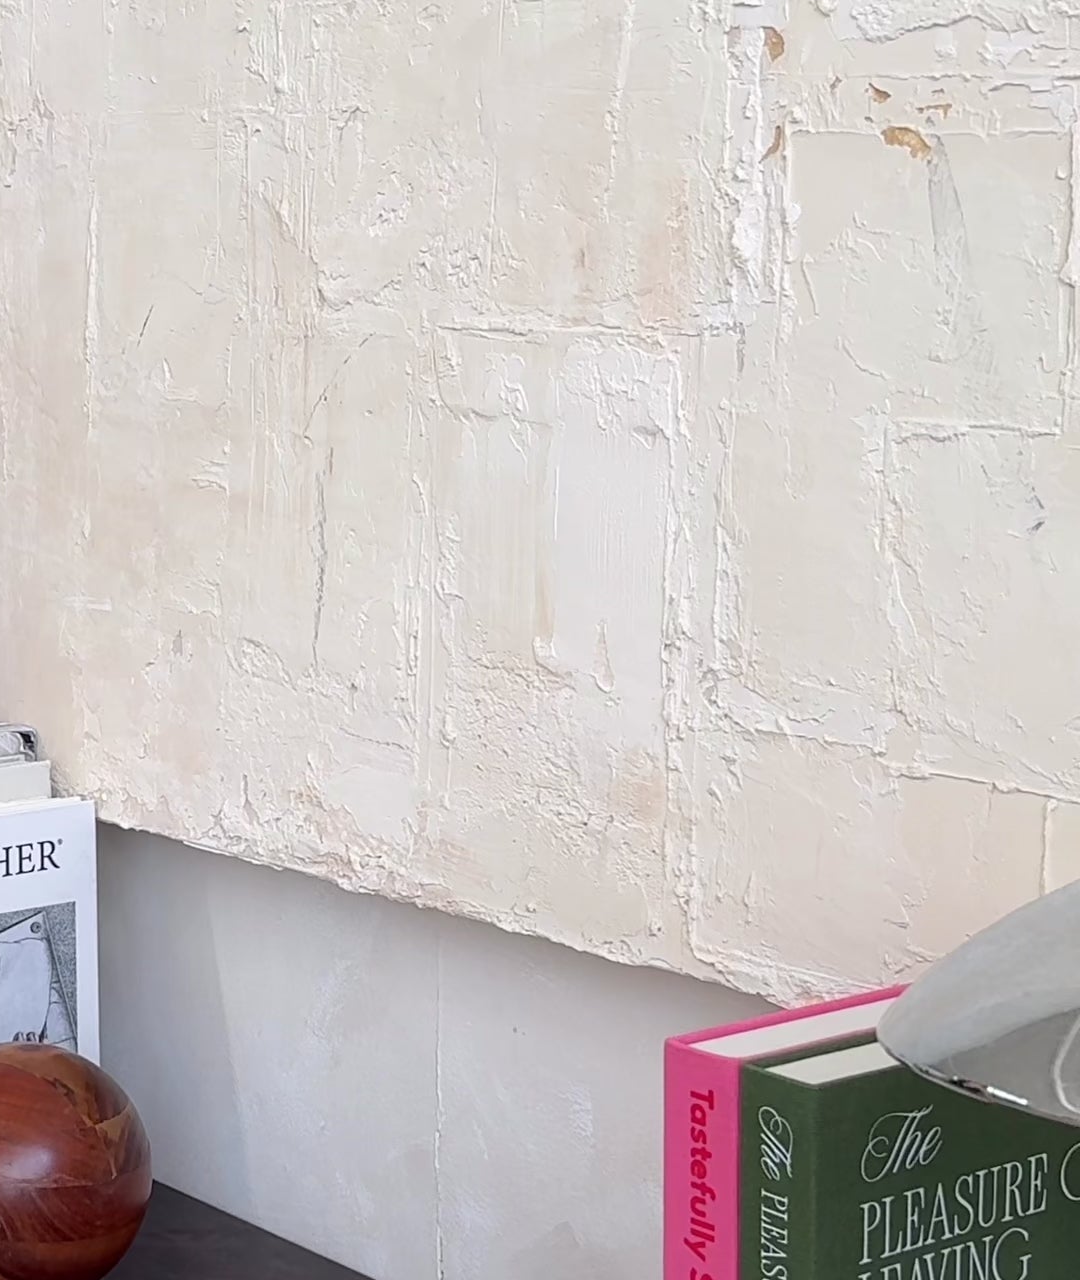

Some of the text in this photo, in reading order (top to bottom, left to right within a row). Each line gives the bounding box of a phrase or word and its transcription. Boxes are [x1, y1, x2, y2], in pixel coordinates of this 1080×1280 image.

[683, 1089, 716, 1262] Tastefully
[758, 1106, 793, 1181] The
[860, 1104, 943, 1182] The
[858, 1153, 1049, 1265] PLEASURE
